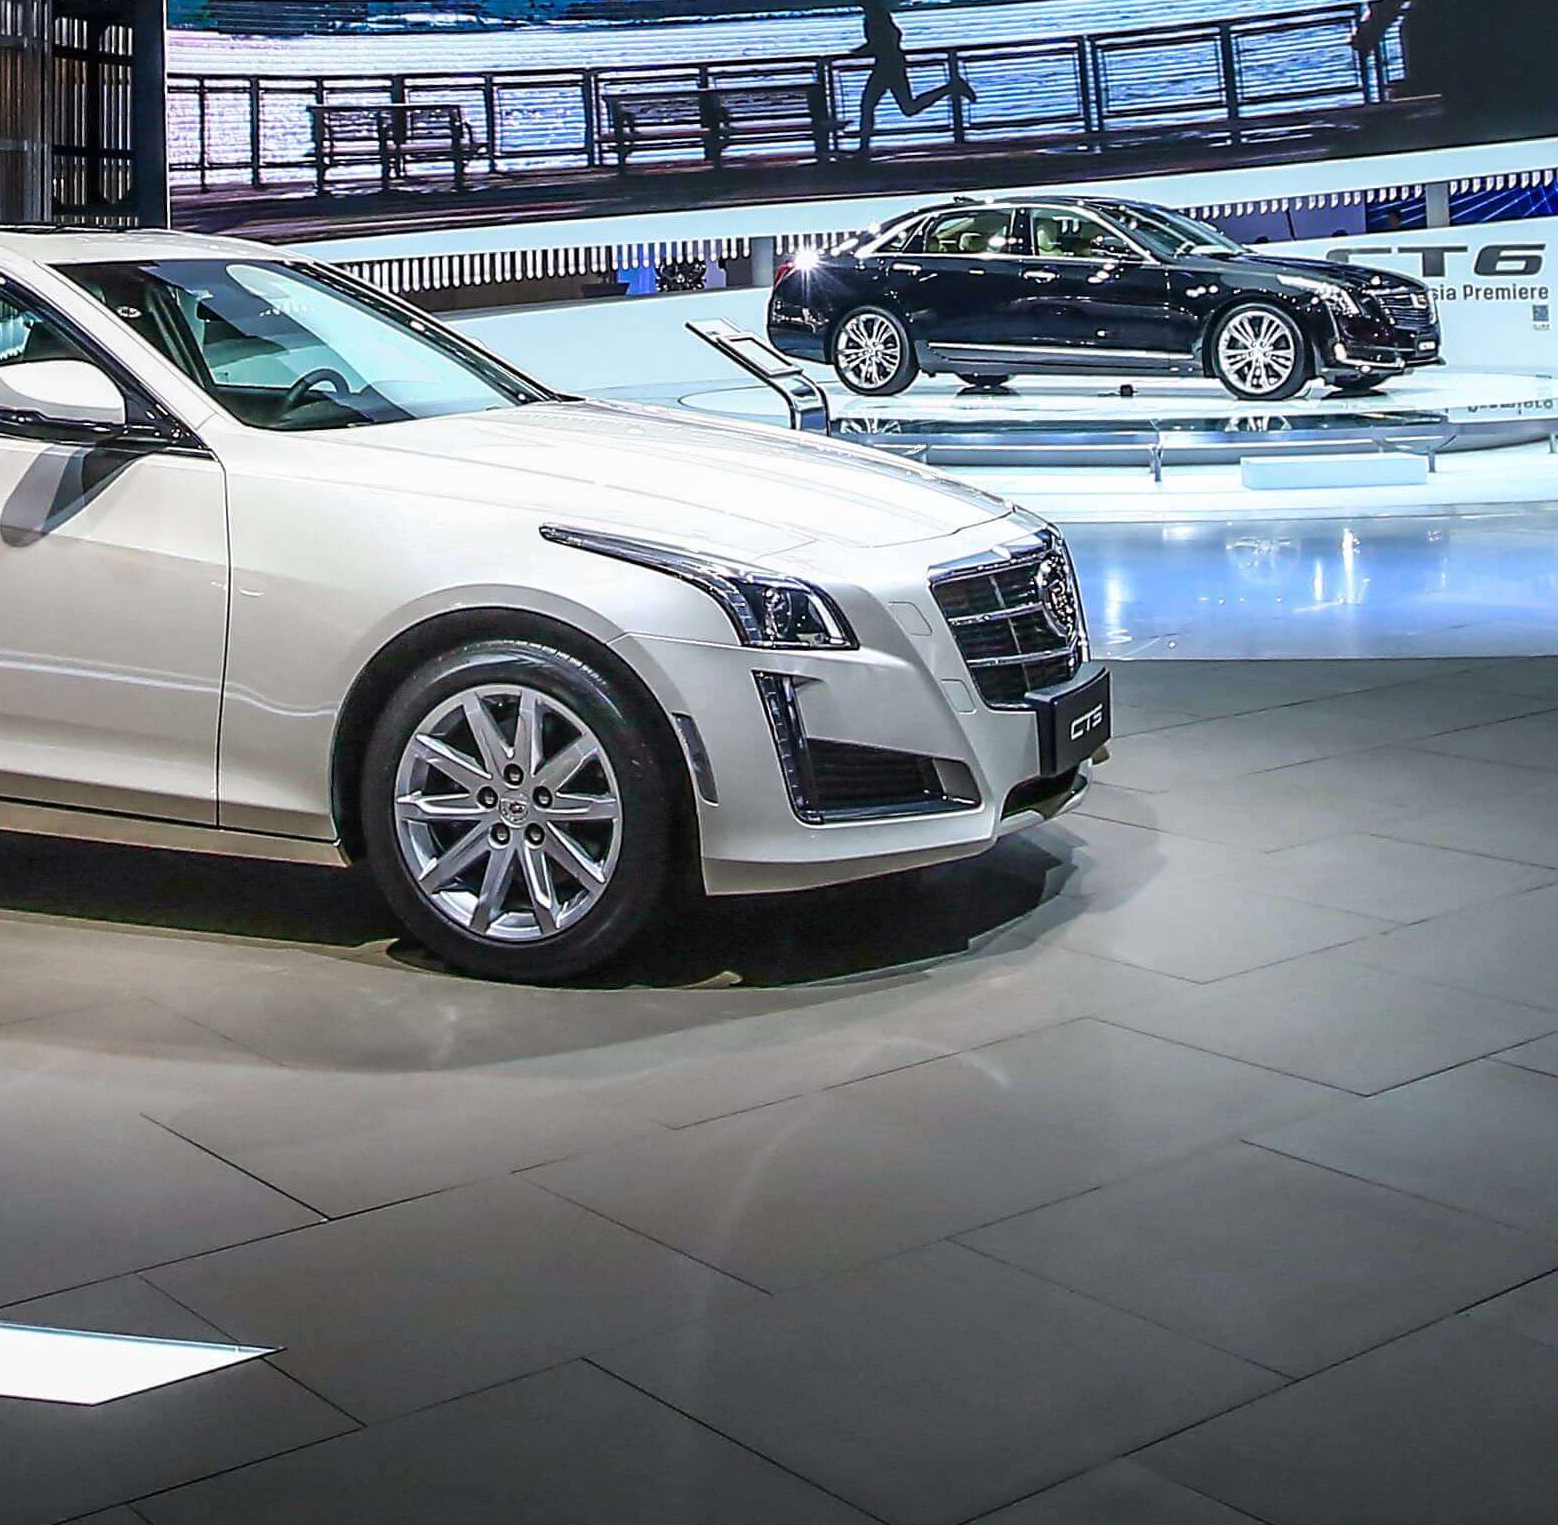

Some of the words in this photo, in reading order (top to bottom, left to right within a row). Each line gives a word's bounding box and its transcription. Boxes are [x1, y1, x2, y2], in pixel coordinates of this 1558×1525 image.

[1431, 283, 1456, 300] sia
[1463, 283, 1549, 301] Premiere
[1070, 703, 1103, 741] CTS
